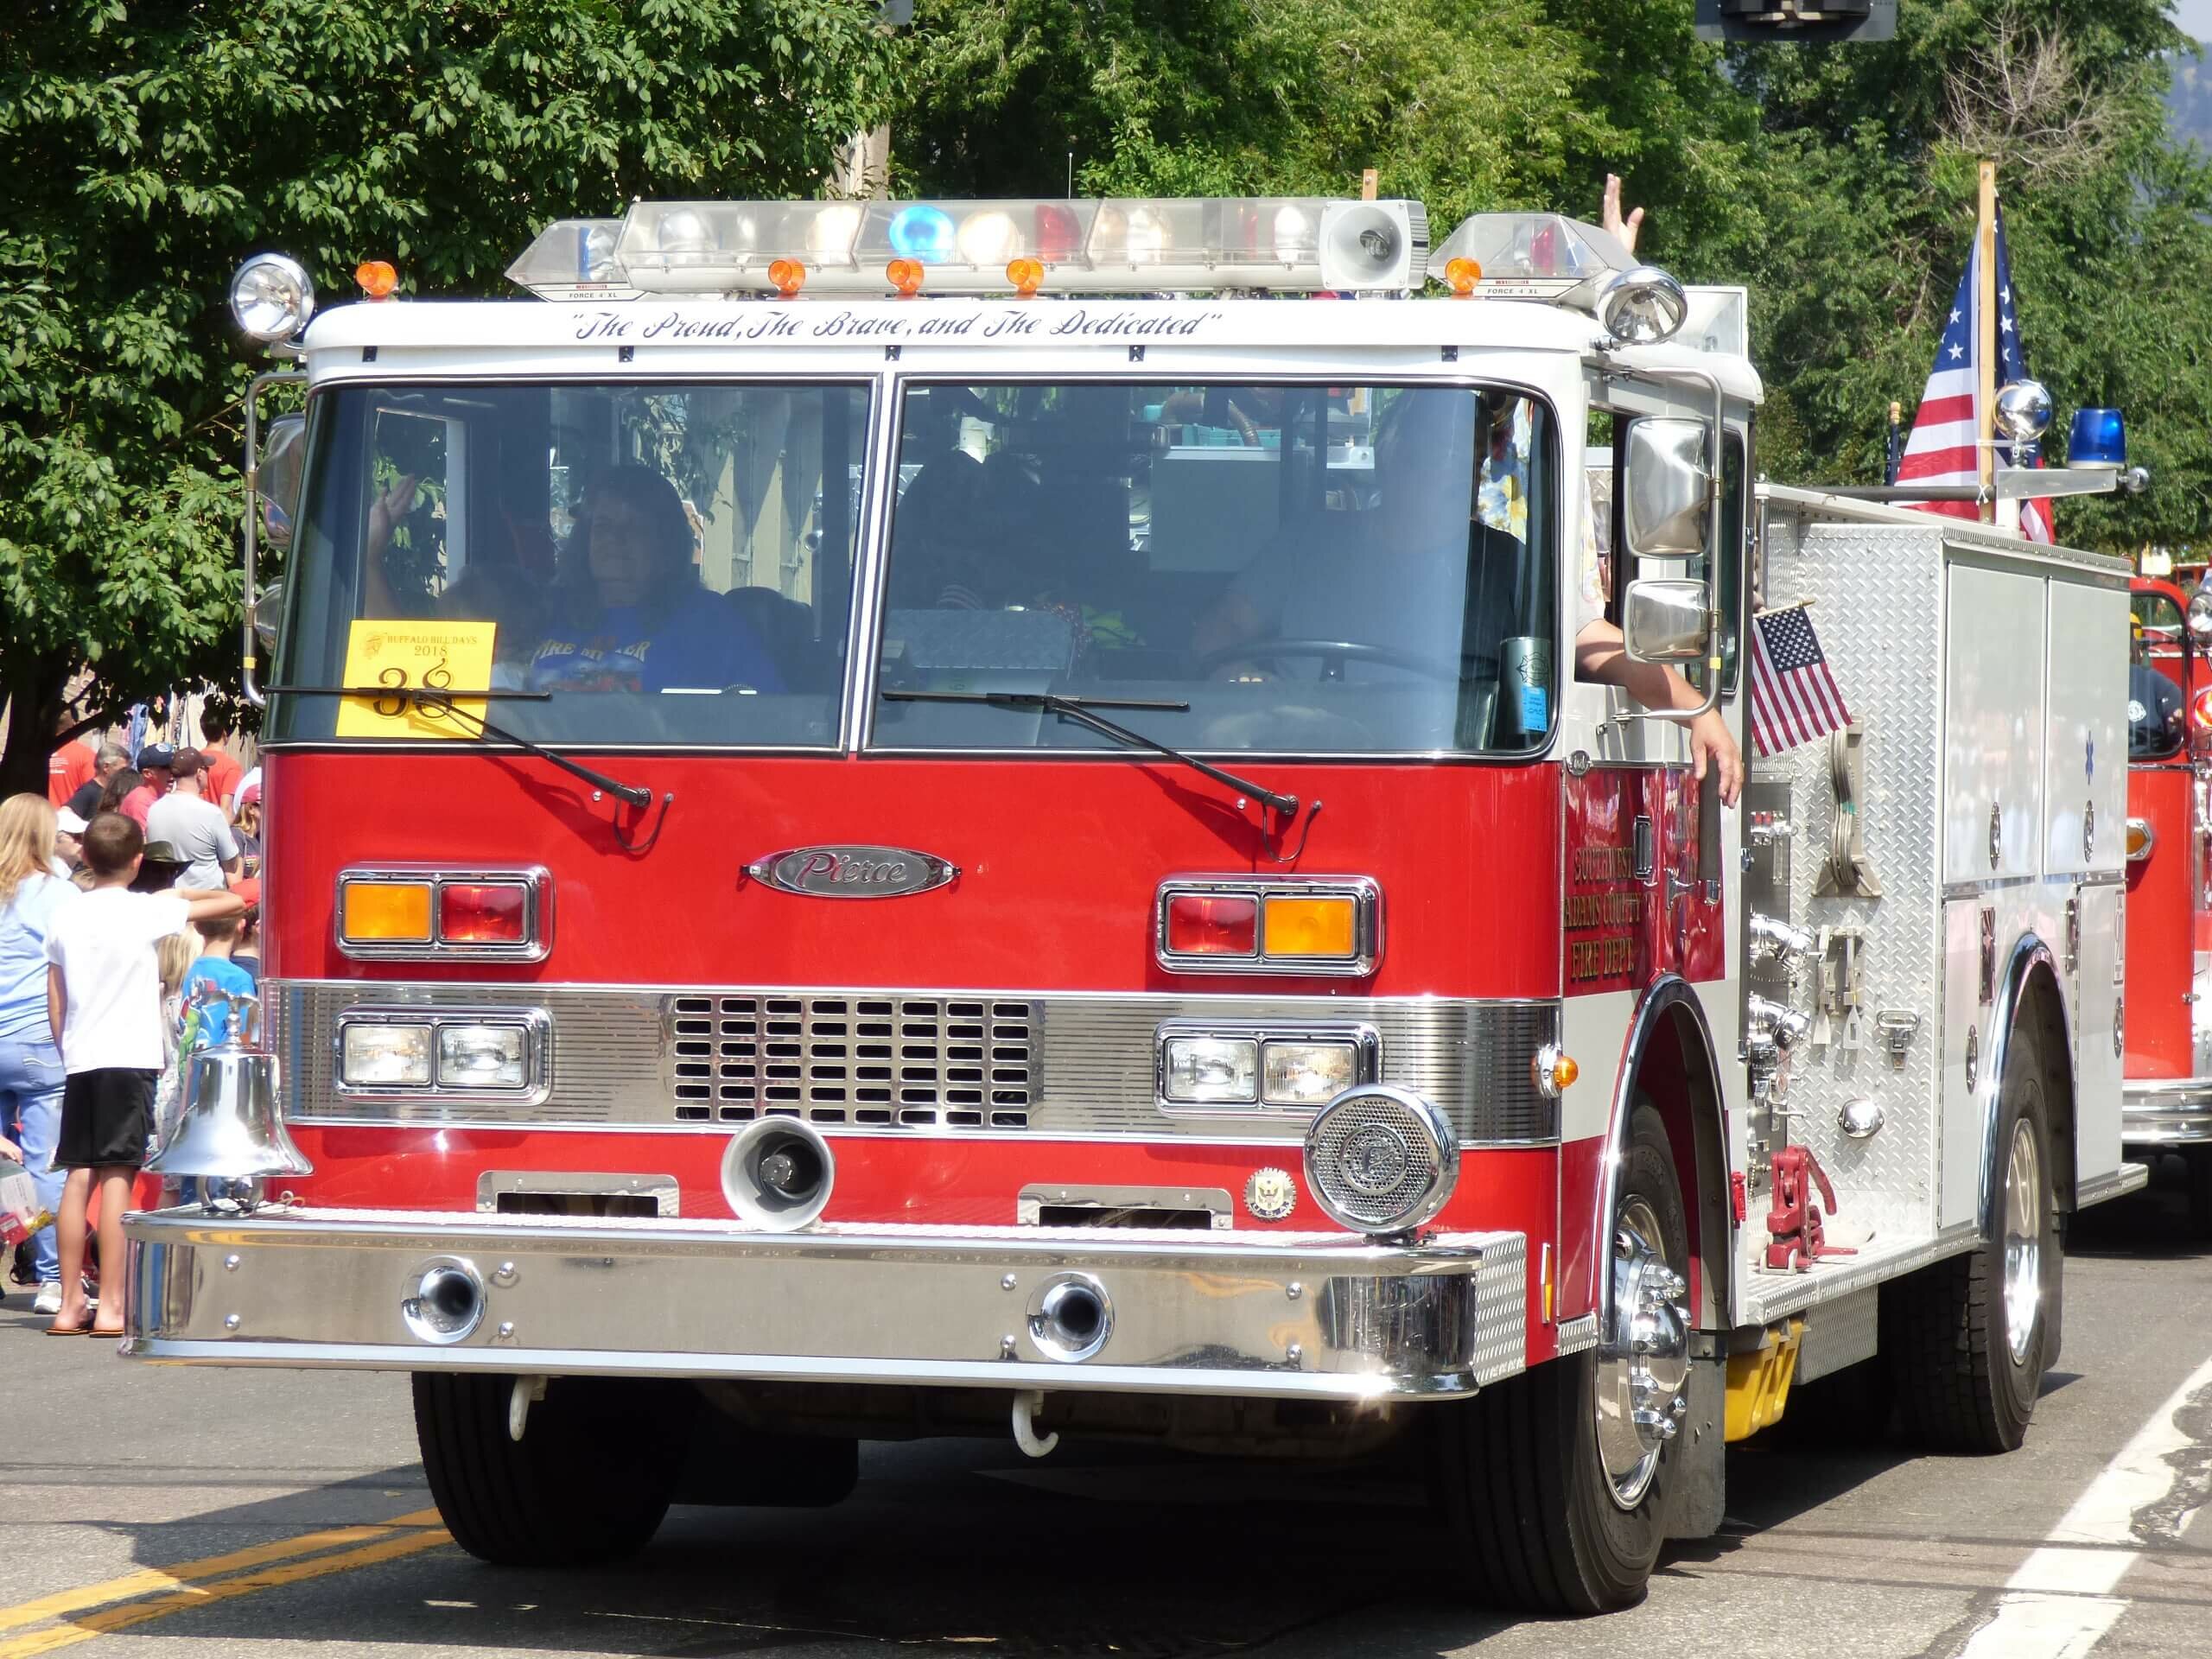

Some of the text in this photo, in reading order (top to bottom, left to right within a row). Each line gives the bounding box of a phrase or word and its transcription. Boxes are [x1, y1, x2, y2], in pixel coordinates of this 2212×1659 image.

[644, 312, 745, 340] Proud,
[747, 311, 804, 340] The
[813, 311, 912, 339] Brave,
[918, 312, 982, 336] and
[983, 310, 1043, 338] The
[386, 635, 478, 644] BUFFALO BILL DAYS
[414, 645, 448, 657] 2018
[794, 851, 907, 888] Pierce
[1564, 893, 1600, 928] ADAMS
[1571, 940, 1600, 977] FIRE
